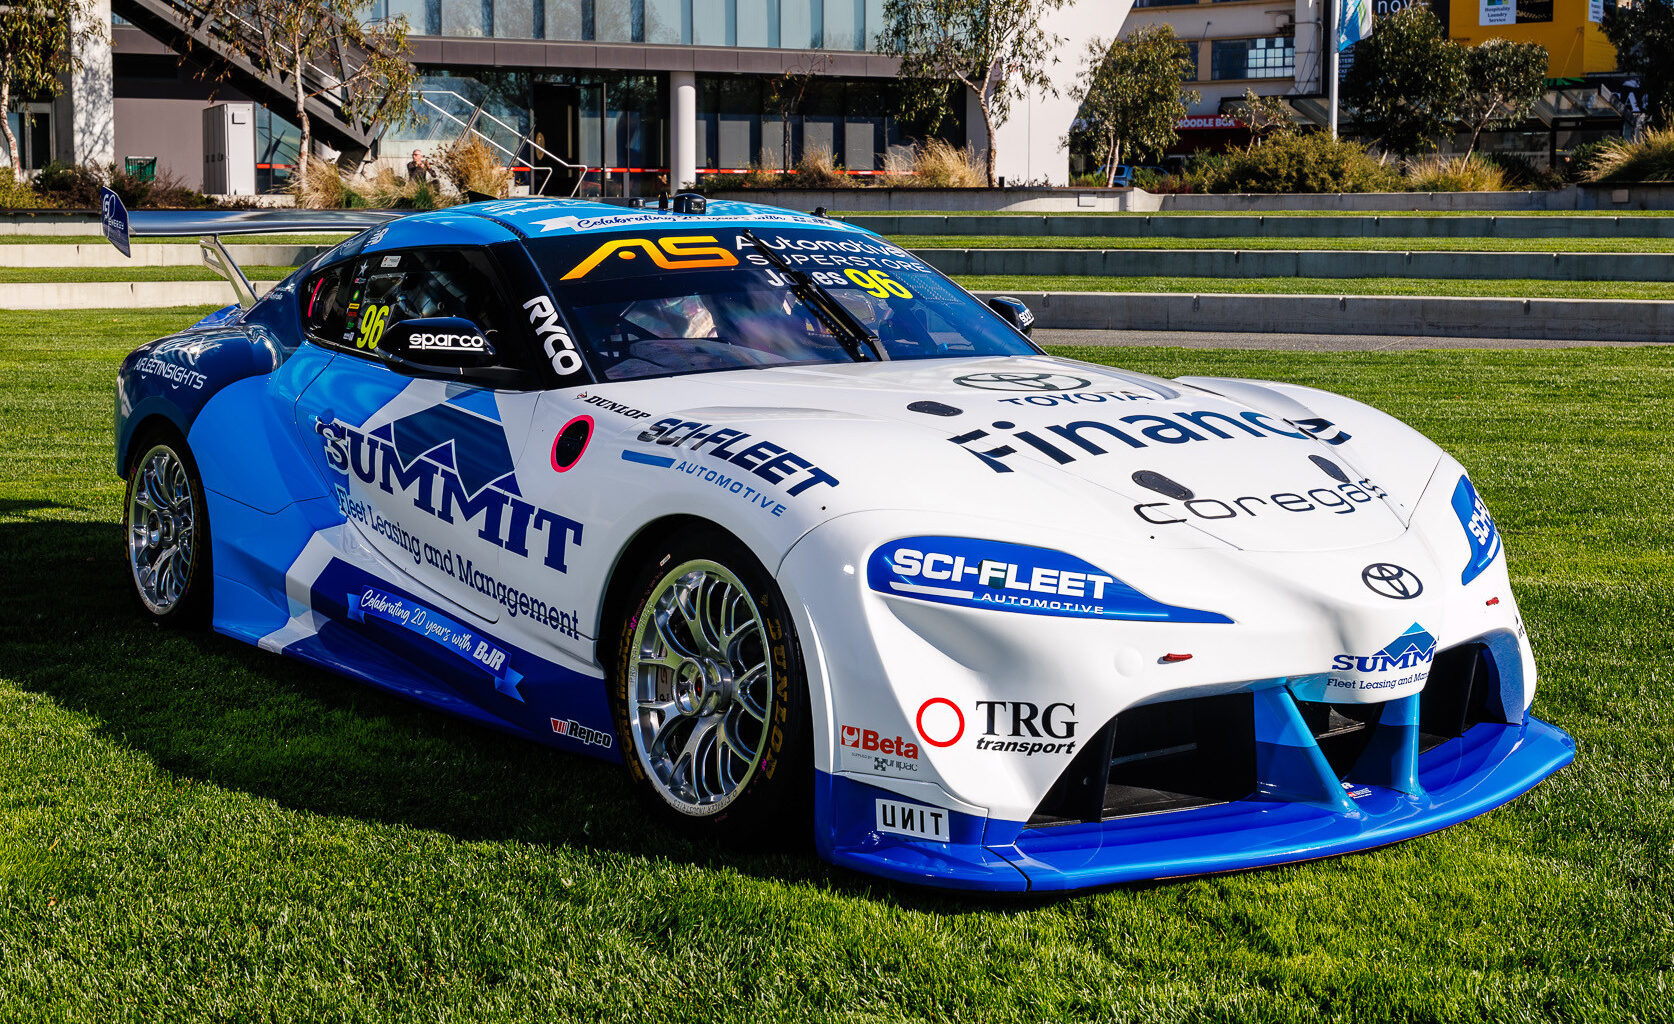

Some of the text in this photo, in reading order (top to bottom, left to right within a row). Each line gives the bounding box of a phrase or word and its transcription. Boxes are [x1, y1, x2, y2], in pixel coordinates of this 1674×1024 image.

[735, 233, 908, 258] Automotive
[843, 268, 914, 299] 96
[356, 304, 390, 350] 96
[409, 330, 484, 351] sparco
[523, 295, 583, 377] RYCO
[584, 394, 652, 420] DUNLOP
[997, 389, 1156, 407] TOYOTA
[636, 417, 841, 498] SCI-FLEET
[946, 409, 1353, 473] Finance
[318, 416, 584, 575] SUMMIT
[675, 460, 788, 518] AUTOMOTIVE
[1132, 478, 1388, 525] coregas
[335, 484, 369, 526] Fleet
[368, 505, 422, 565] Leasing
[424, 543, 455, 578] and
[456, 554, 580, 641] Management
[891, 548, 1114, 600] SCI-FLEET
[981, 592, 1104, 615] AUTOMOTIVE
[360, 589, 507, 671] Celebrating 20 years with BJR
[767, 616, 788, 780] DUNLOP
[1326, 678, 1356, 689] Fleet
[1359, 678, 1397, 690] Leasing
[1397, 674, 1413, 686] and
[566, 718, 612, 749] Repco
[975, 700, 1079, 739] TRG
[862, 729, 919, 760] Beta
[975, 736, 1077, 757] transport
